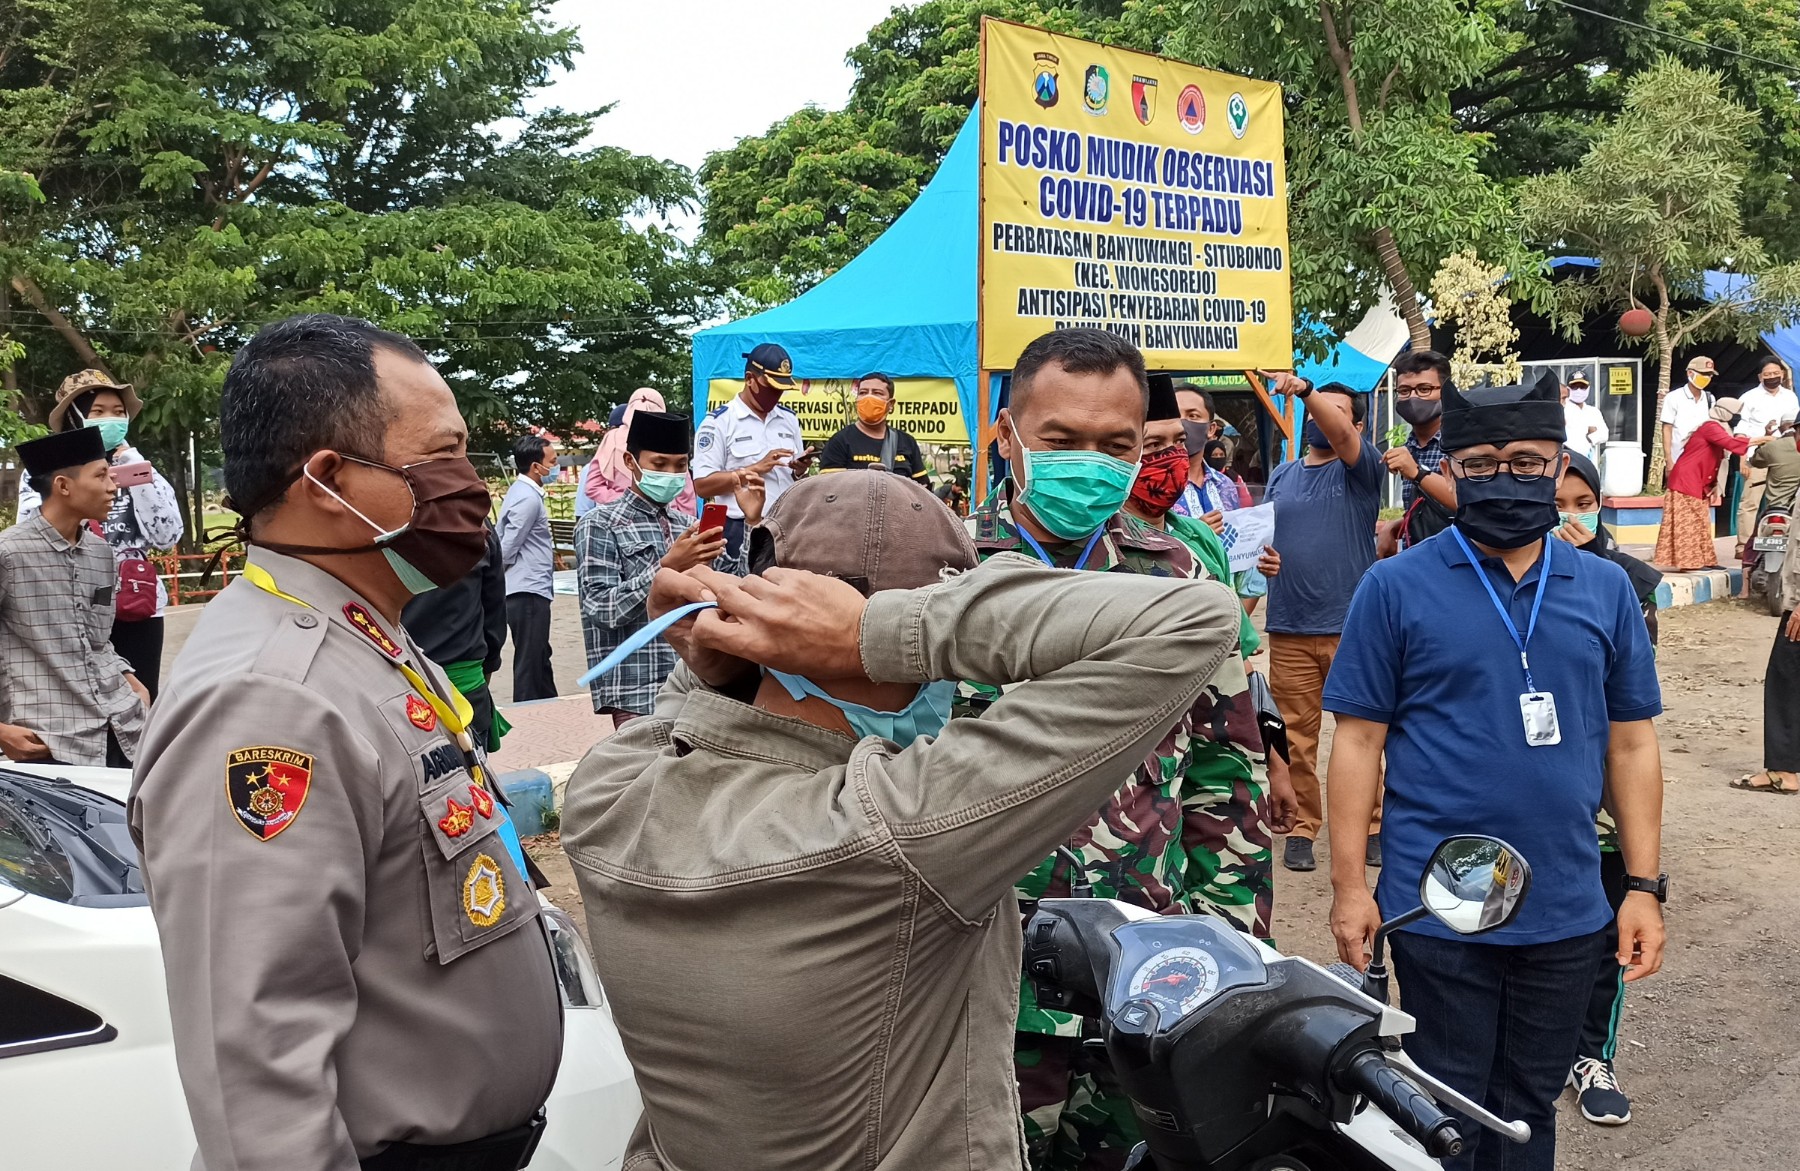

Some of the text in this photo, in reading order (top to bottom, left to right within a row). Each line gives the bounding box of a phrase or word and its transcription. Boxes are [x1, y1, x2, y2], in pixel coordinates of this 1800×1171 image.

[999, 120, 1273, 196] POSKO MUDIK OBSERVASI
[1040, 176, 1241, 235] COVID-19 TERPADU
[993, 222, 1092, 258] PERBATASAN
[1096, 234, 1192, 266] BANYUWANGI
[1203, 243, 1282, 270] SITUBONDO
[1075, 261, 1216, 294] (KEC. WONGSOREJO)
[1017, 288, 1266, 323] ANTISIPASI PENYEBARAN COVID-19
[1144, 324, 1238, 349] BANYUWANGI
[897, 401, 958, 415] TERPADU
[235, 749, 306, 767] BARESKRIM
